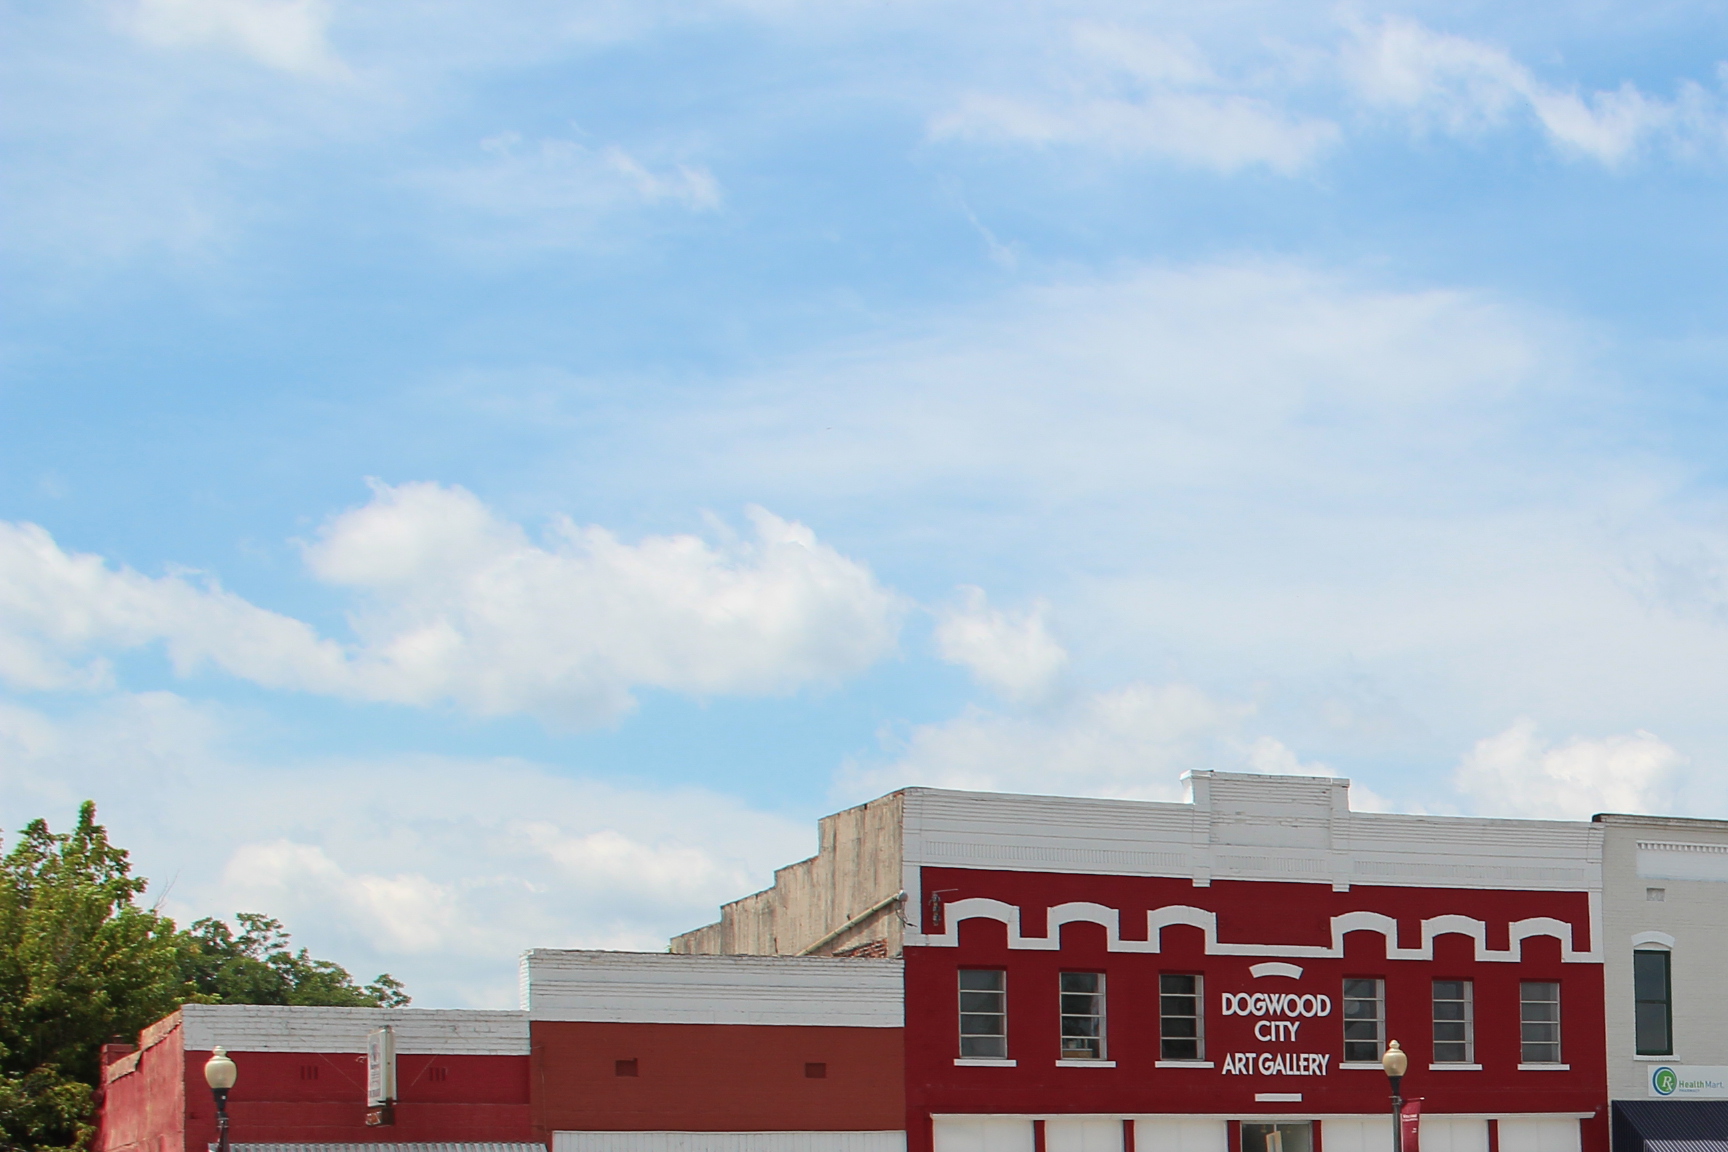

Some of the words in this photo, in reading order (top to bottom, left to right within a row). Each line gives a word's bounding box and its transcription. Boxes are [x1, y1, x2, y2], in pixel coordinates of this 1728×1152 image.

[1221, 992, 1331, 1017] DOGWOOD
[1254, 1020, 1300, 1042] CITY
[1221, 1052, 1257, 1075] ART
[1258, 1052, 1330, 1076] GALLERY
